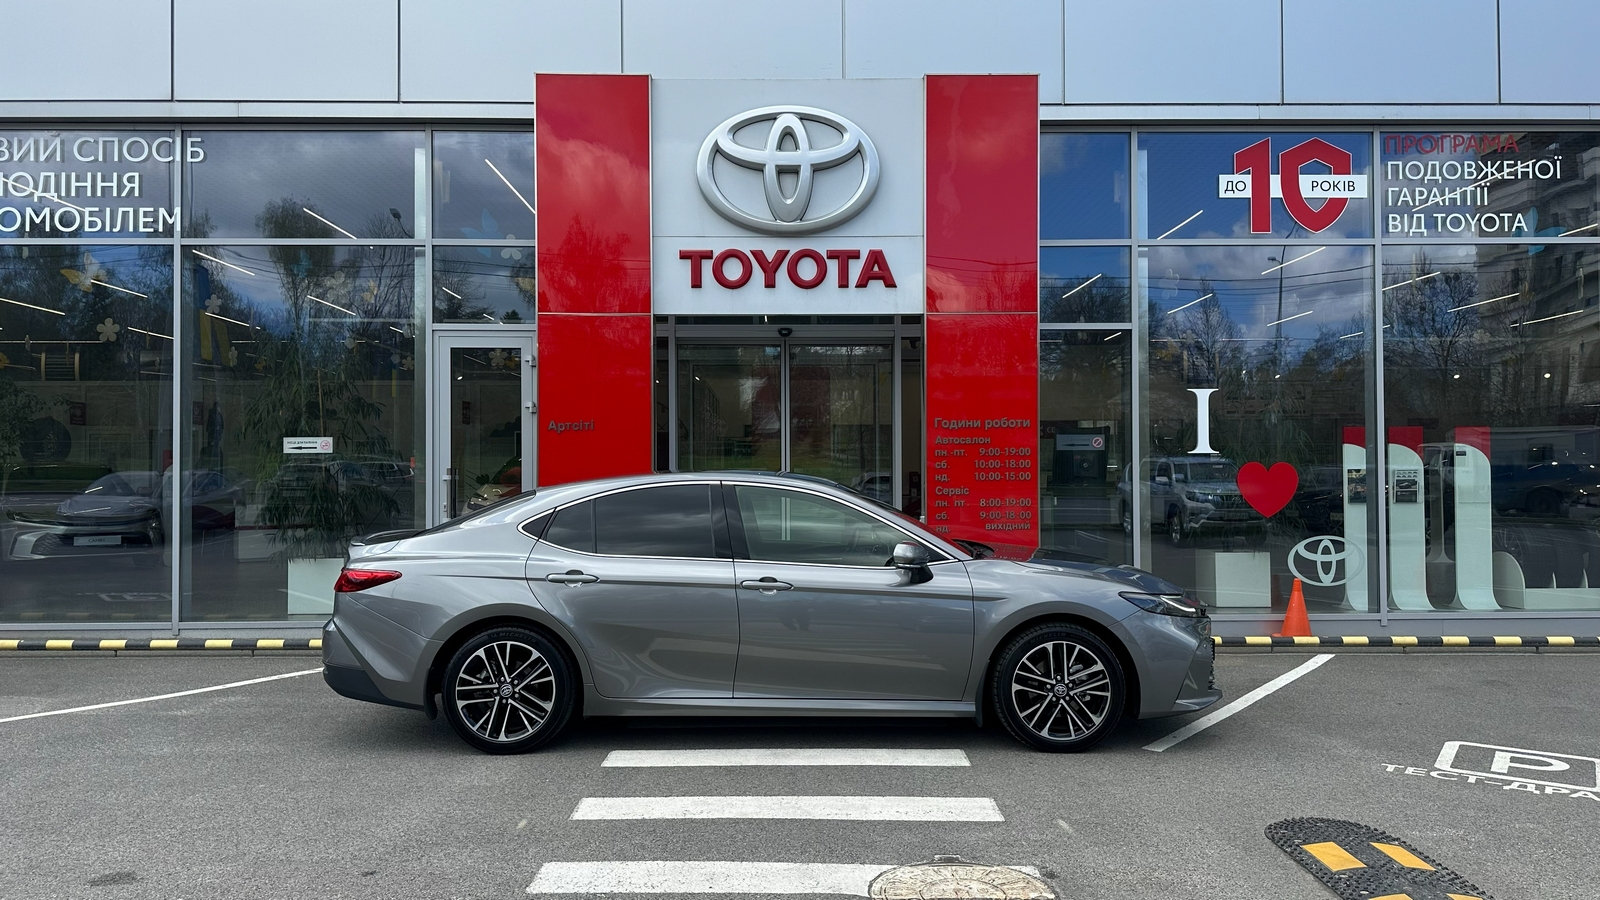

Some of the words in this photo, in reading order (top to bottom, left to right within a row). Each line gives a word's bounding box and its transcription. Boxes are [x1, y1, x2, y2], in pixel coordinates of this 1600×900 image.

[73, 136, 205, 163] СПОСІБ
[1385, 134, 1519, 154] ПРОГРАМА
[1386, 155, 1562, 184] ПОДОВЖЕНОЇ
[0, 171, 140, 202] ОДІННЯ
[1224, 180, 1247, 194] ДО
[1233, 136, 1353, 234] 10
[1310, 180, 1356, 192] РОКІВ
[1387, 183, 1489, 206] ГАРАНТІЇ
[1388, 213, 1428, 236] ВІД
[1432, 212, 1529, 233] TOYOTA
[679, 248, 898, 290] TOYOTA
[547, 419, 595, 434] Артсіті
[934, 417, 981, 430] Години
[984, 417, 1031, 430] роботи
[1186, 388, 1220, 454] I
[935, 436, 991, 445] Автосалон
[979, 447, 1031, 456] 9:00-19:00
[935, 460, 950, 469] сб.
[974, 460, 1031, 469] 10:00-18:00
[935, 474, 950, 482] нд.
[974, 472, 1032, 481] 10:00-15:00
[935, 486, 970, 497] Сервіс
[979, 498, 1032, 507] 8:00-19:00
[935, 511, 950, 520] сб.
[980, 510, 1032, 520] 9:00-18:00
[985, 521, 1031, 531] вихідний
[1490, 750, 1570, 774] P
[1381, 763, 1600, 802] ТЕСТ-ДРА
